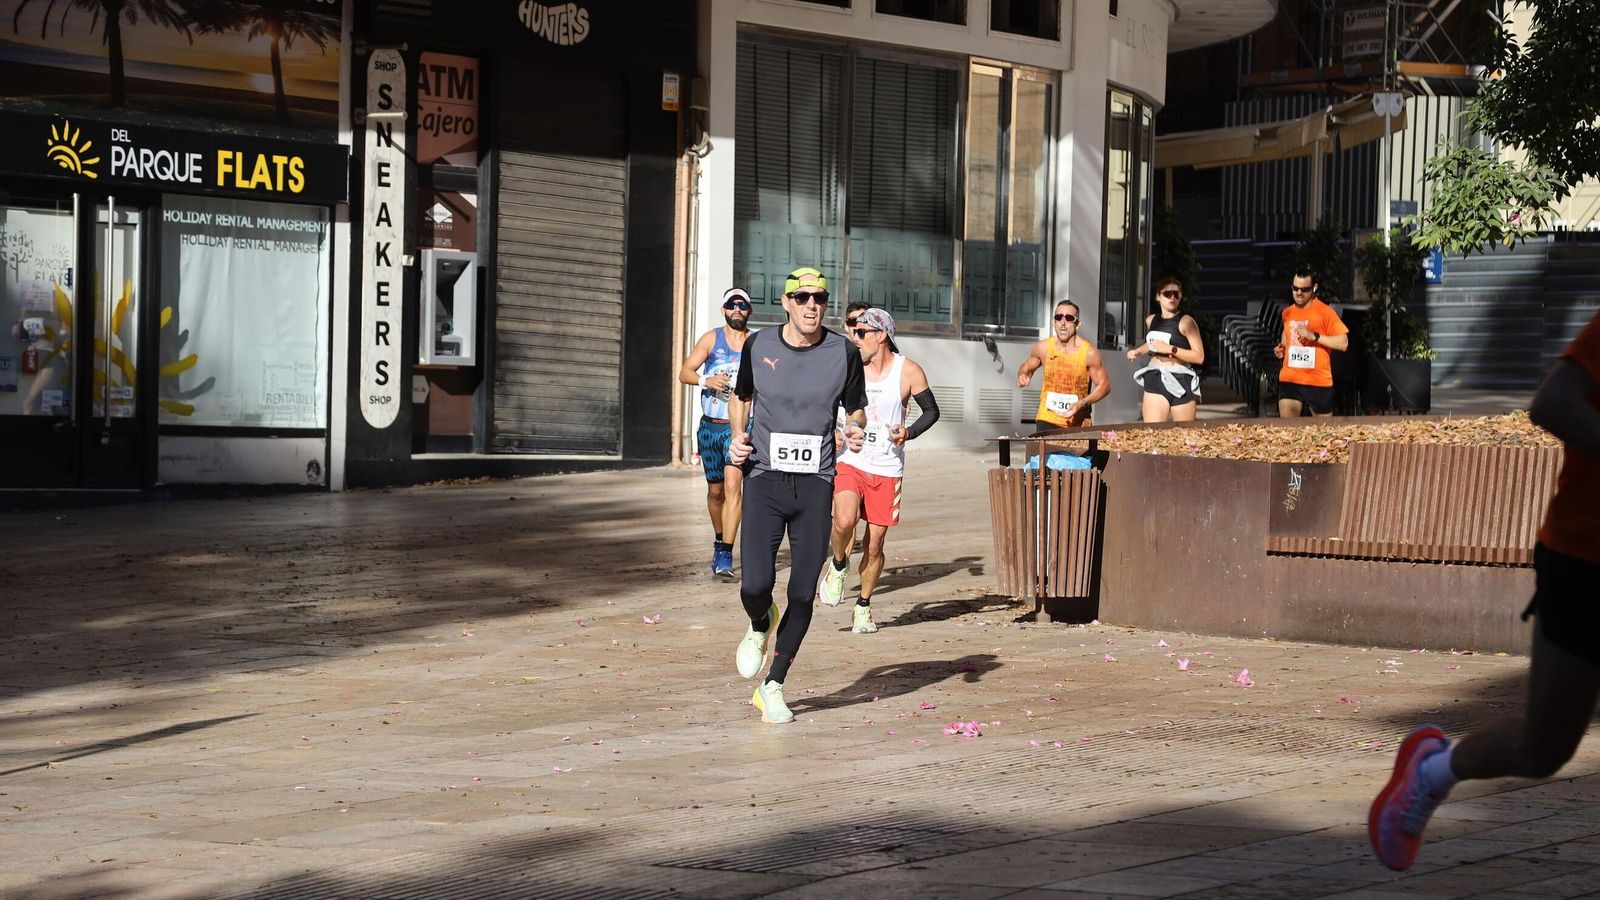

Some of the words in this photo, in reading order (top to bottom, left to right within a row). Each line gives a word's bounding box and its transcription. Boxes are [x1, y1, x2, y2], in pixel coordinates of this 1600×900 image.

[518, 0, 590, 45] HUNTERS
[374, 60, 397, 72] SHOP
[111, 128, 131, 143] DEL
[110, 145, 203, 184] PARQUE
[216, 149, 305, 193] FLATS
[163, 210, 212, 225] HOLIDAY
[215, 213, 254, 228] RENTAL
[256, 217, 326, 234] MANAGEMENT
[374, 83, 393, 387] SNEAKERS
[1291, 353, 1310, 362] 952
[369, 394, 392, 406] SHOP
[778, 447, 813, 462] 510
